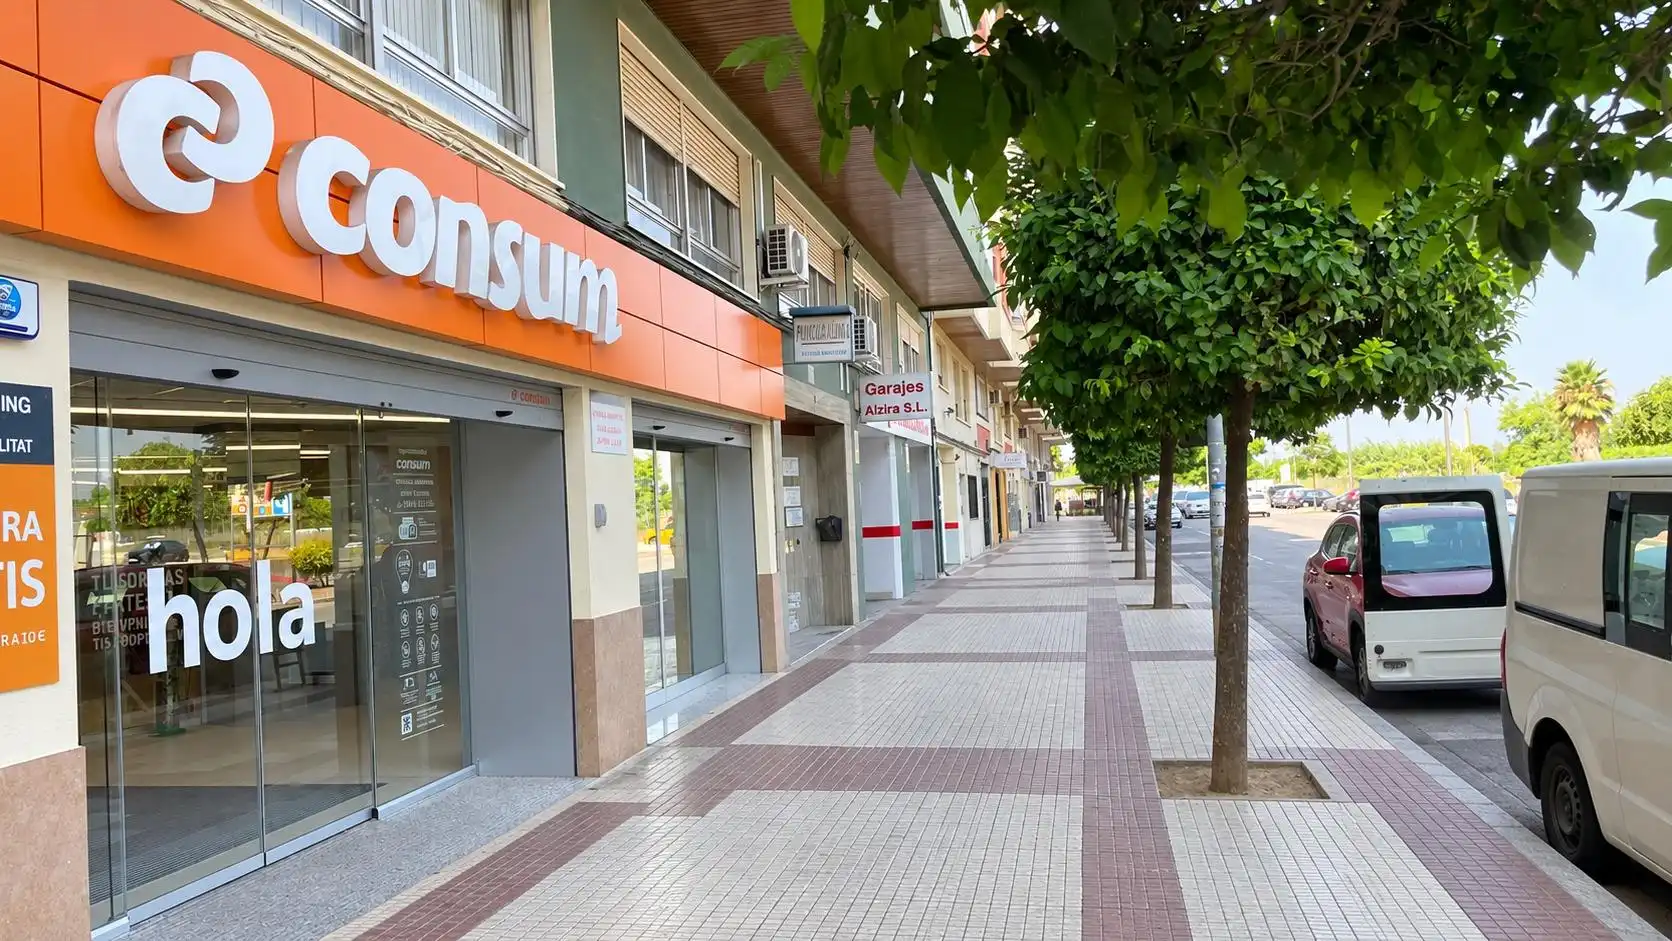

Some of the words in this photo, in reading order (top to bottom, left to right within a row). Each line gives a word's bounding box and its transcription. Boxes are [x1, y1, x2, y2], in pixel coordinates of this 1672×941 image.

[278, 135, 622, 344] consum
[865, 381, 924, 397] Garajes
[865, 404, 900, 416] Alzira
[904, 402, 928, 413] S.L.
[396, 459, 431, 470] consum
[2, 510, 44, 542] RA
[0, 559, 46, 610] IS
[147, 559, 316, 675] hola
